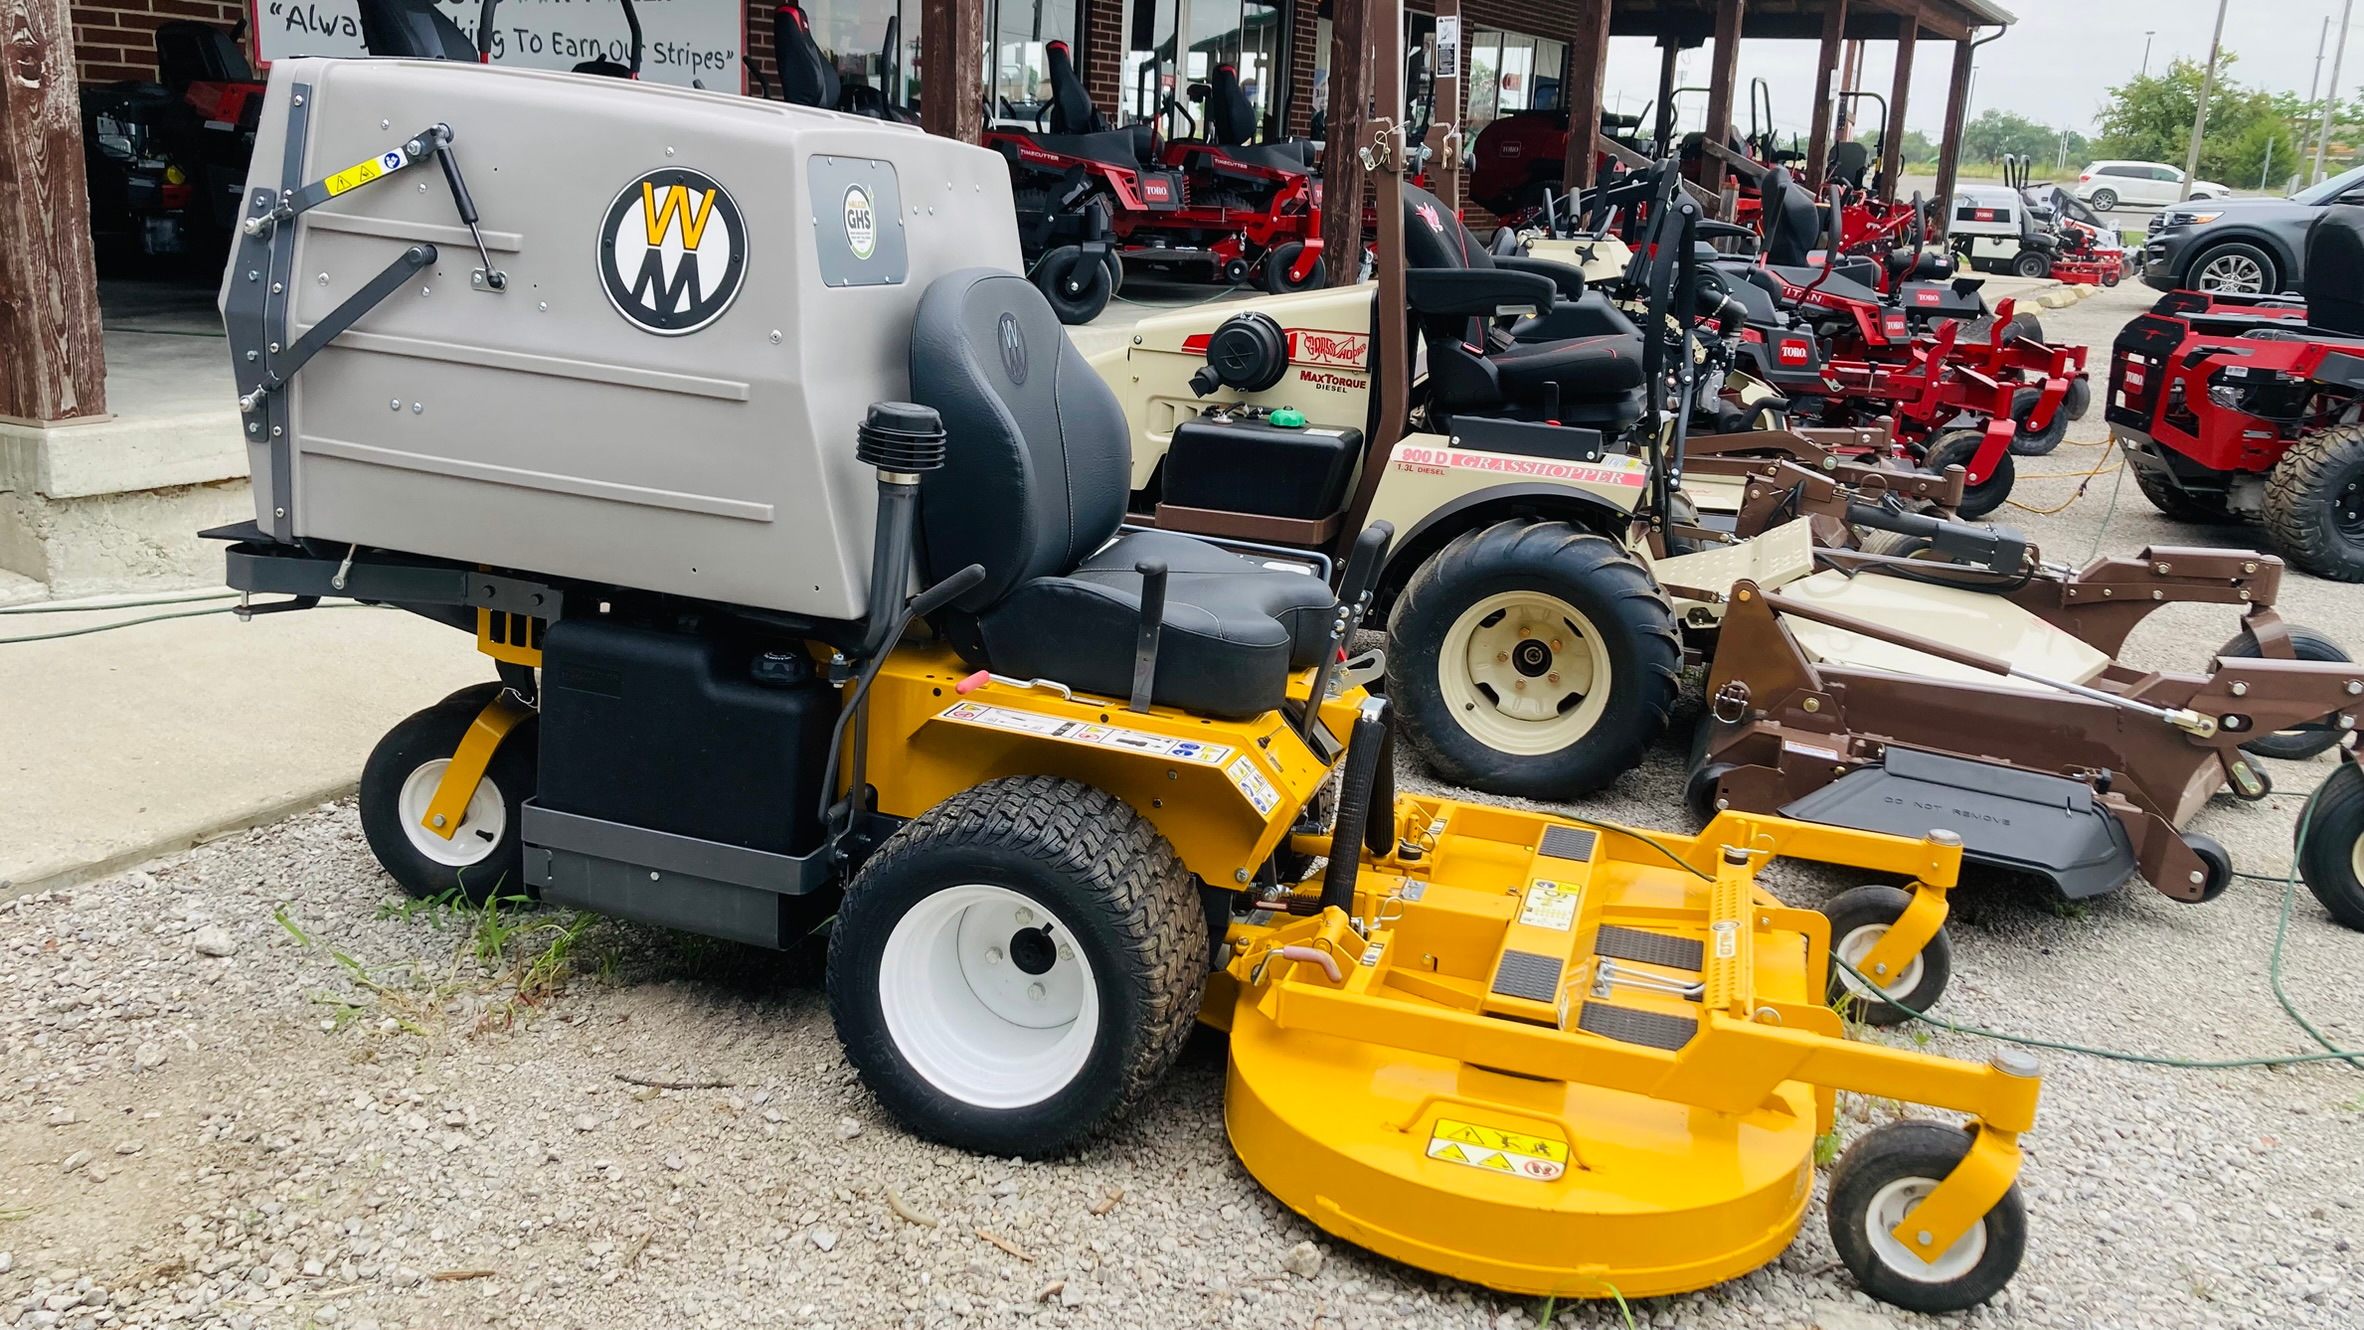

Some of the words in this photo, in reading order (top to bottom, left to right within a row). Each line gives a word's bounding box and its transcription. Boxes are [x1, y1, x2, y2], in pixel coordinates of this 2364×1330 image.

[513, 28, 543, 53] To
[552, 32, 600, 57] Earn
[1020, 149, 1059, 161] TIMECUTTER
[1214, 158, 1248, 169] TIMECUTTER
[1145, 186, 1168, 196] TORO
[847, 208, 871, 230] GHS
[1783, 286, 1822, 303] ITN
[1918, 293, 1940, 302] TORO
[1886, 321, 1905, 331] TORO
[1782, 346, 1807, 357] TORO
[2125, 370, 2144, 386] TORO
[1316, 383, 1348, 393] DIESEL
[1397, 463, 1414, 472] 1.3L
[1417, 467, 1446, 475] DIESEL
[1402, 448, 1432, 463] 900
[1435, 451, 1448, 465] D
[1460, 455, 1625, 485] GRASSHOPPER
[1884, 796, 1903, 805] DO
[1913, 801, 1942, 812] NOT
[1952, 808, 2011, 826] REMOVE
